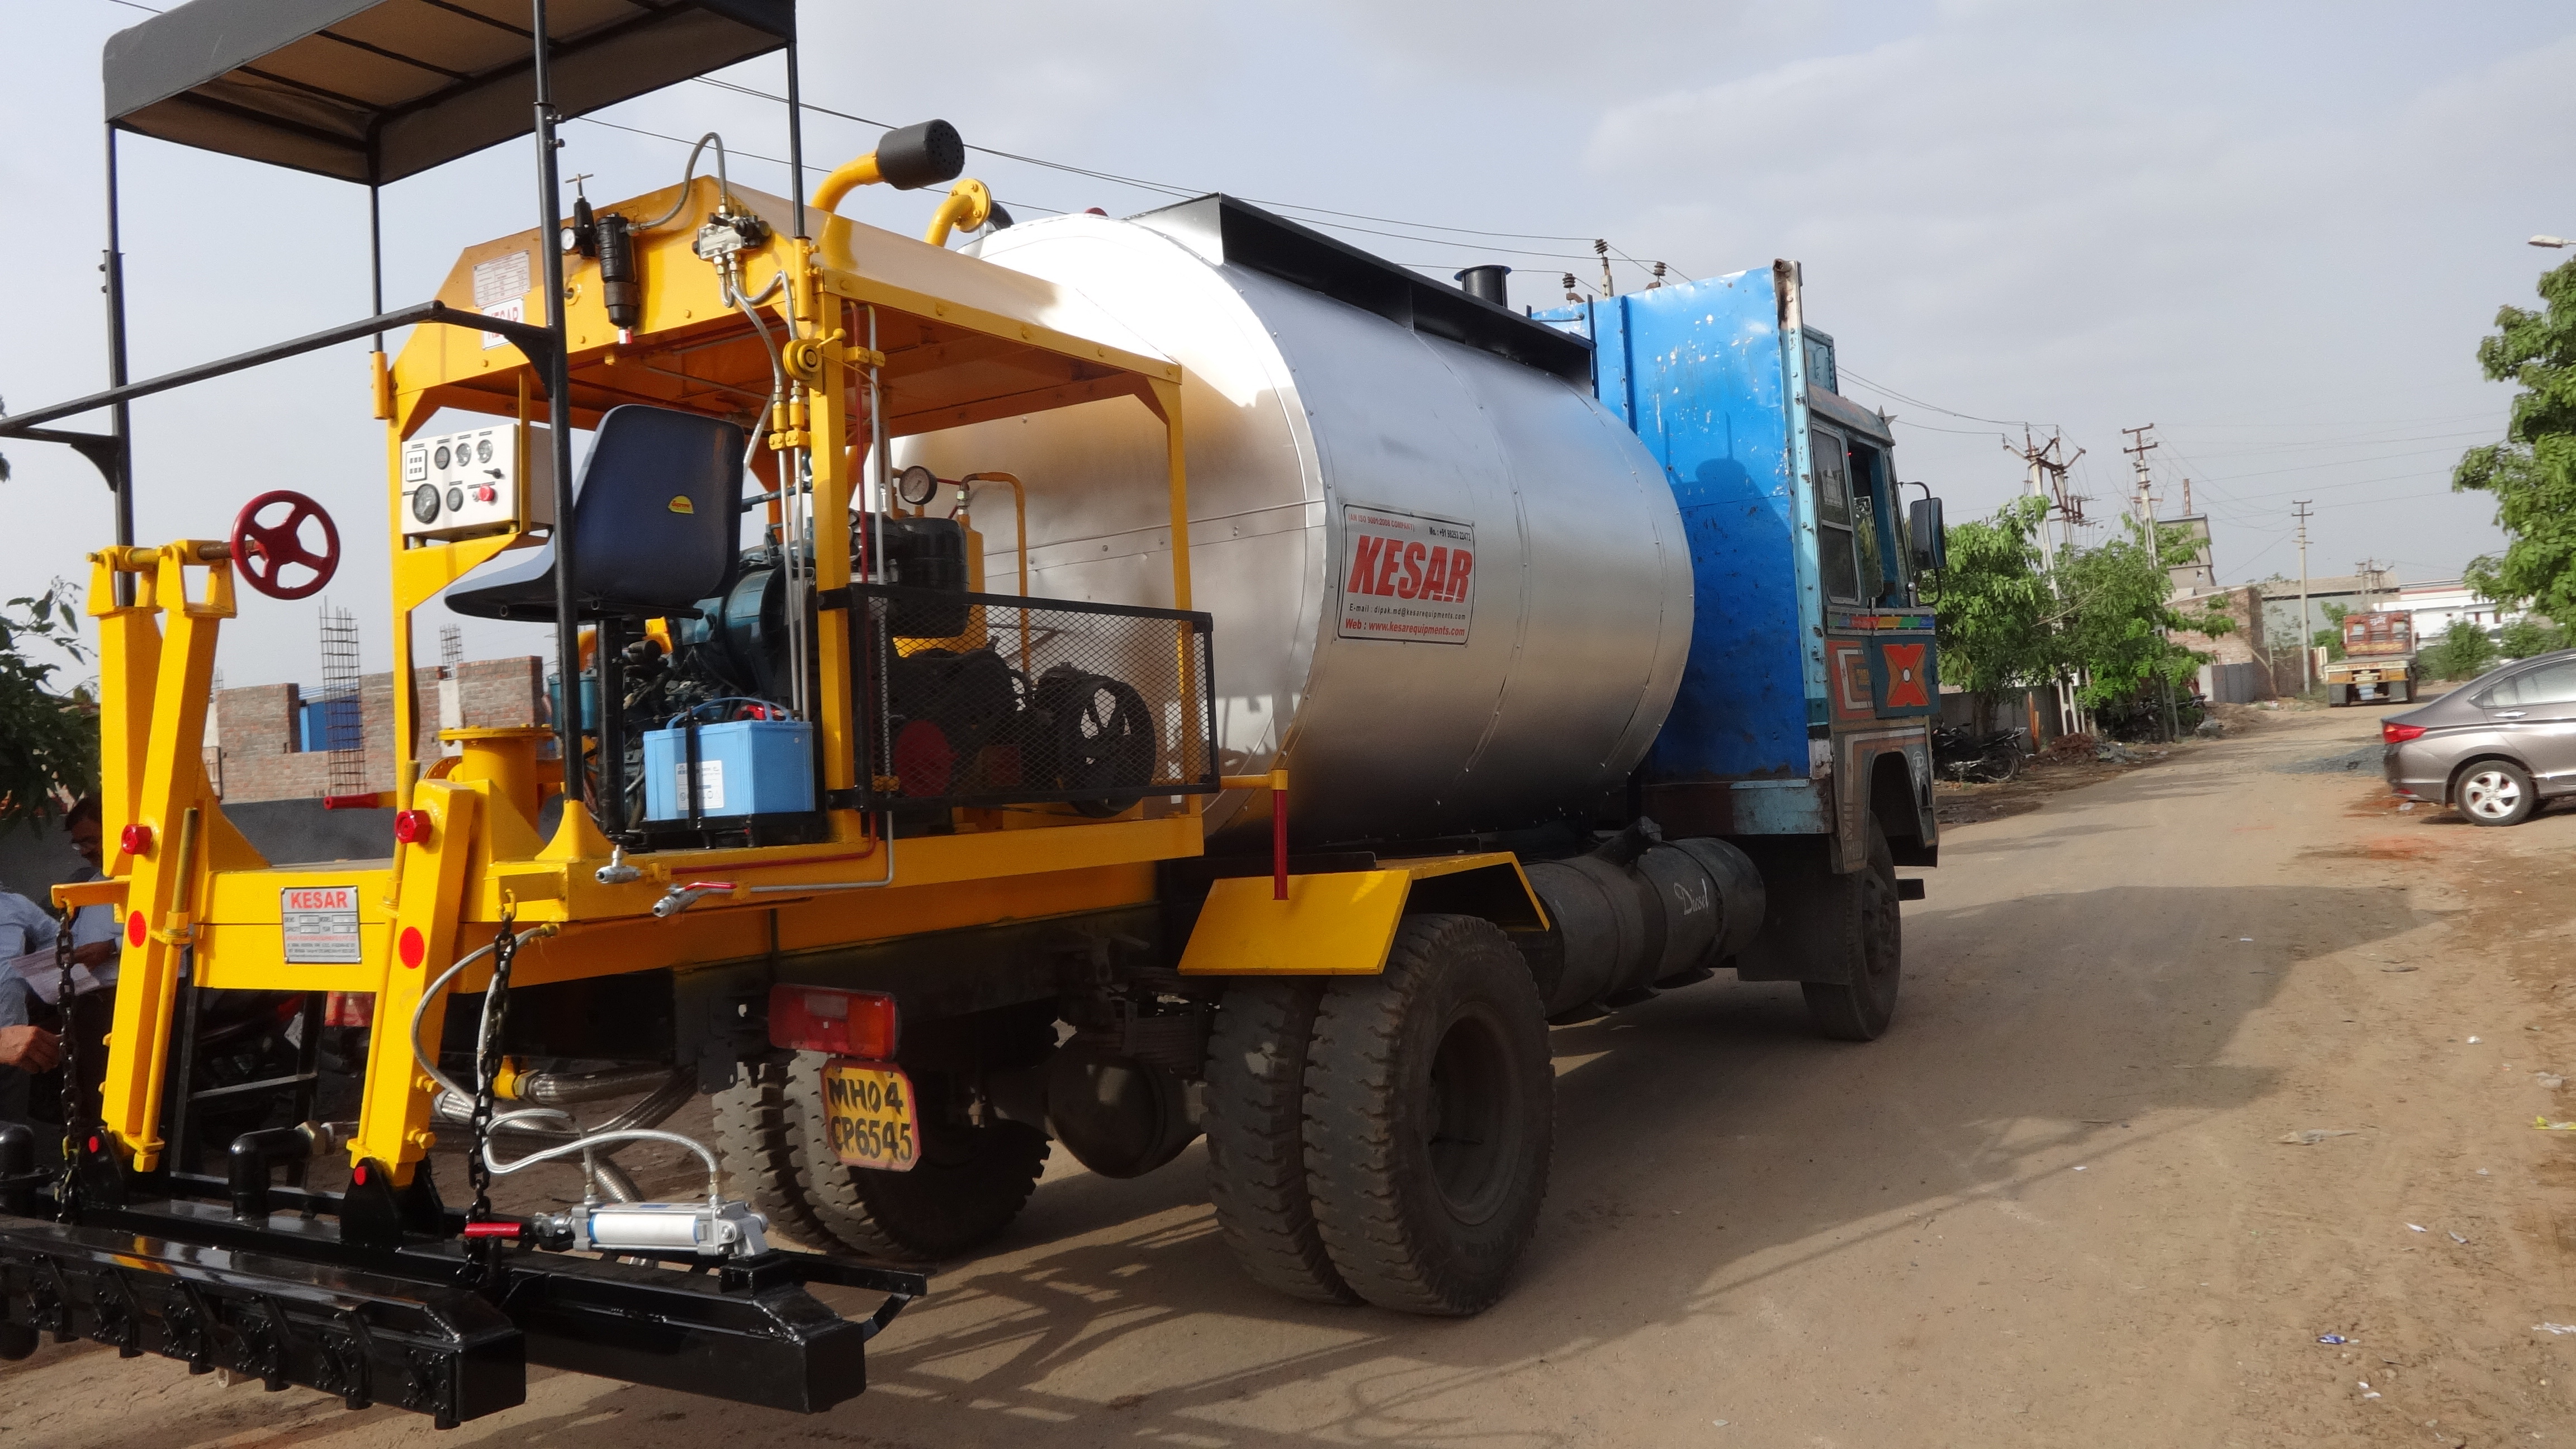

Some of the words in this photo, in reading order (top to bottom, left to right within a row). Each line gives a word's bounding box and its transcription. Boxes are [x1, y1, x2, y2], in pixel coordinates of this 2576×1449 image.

[1358, 514, 1367, 523] ISO
[1346, 534, 1473, 604] KESAR
[1349, 603, 1369, 613] E-mail
[1345, 618, 1362, 630] Web
[1369, 621, 1465, 636] www.kesarequipments.com
[290, 891, 348, 909] KESAR
